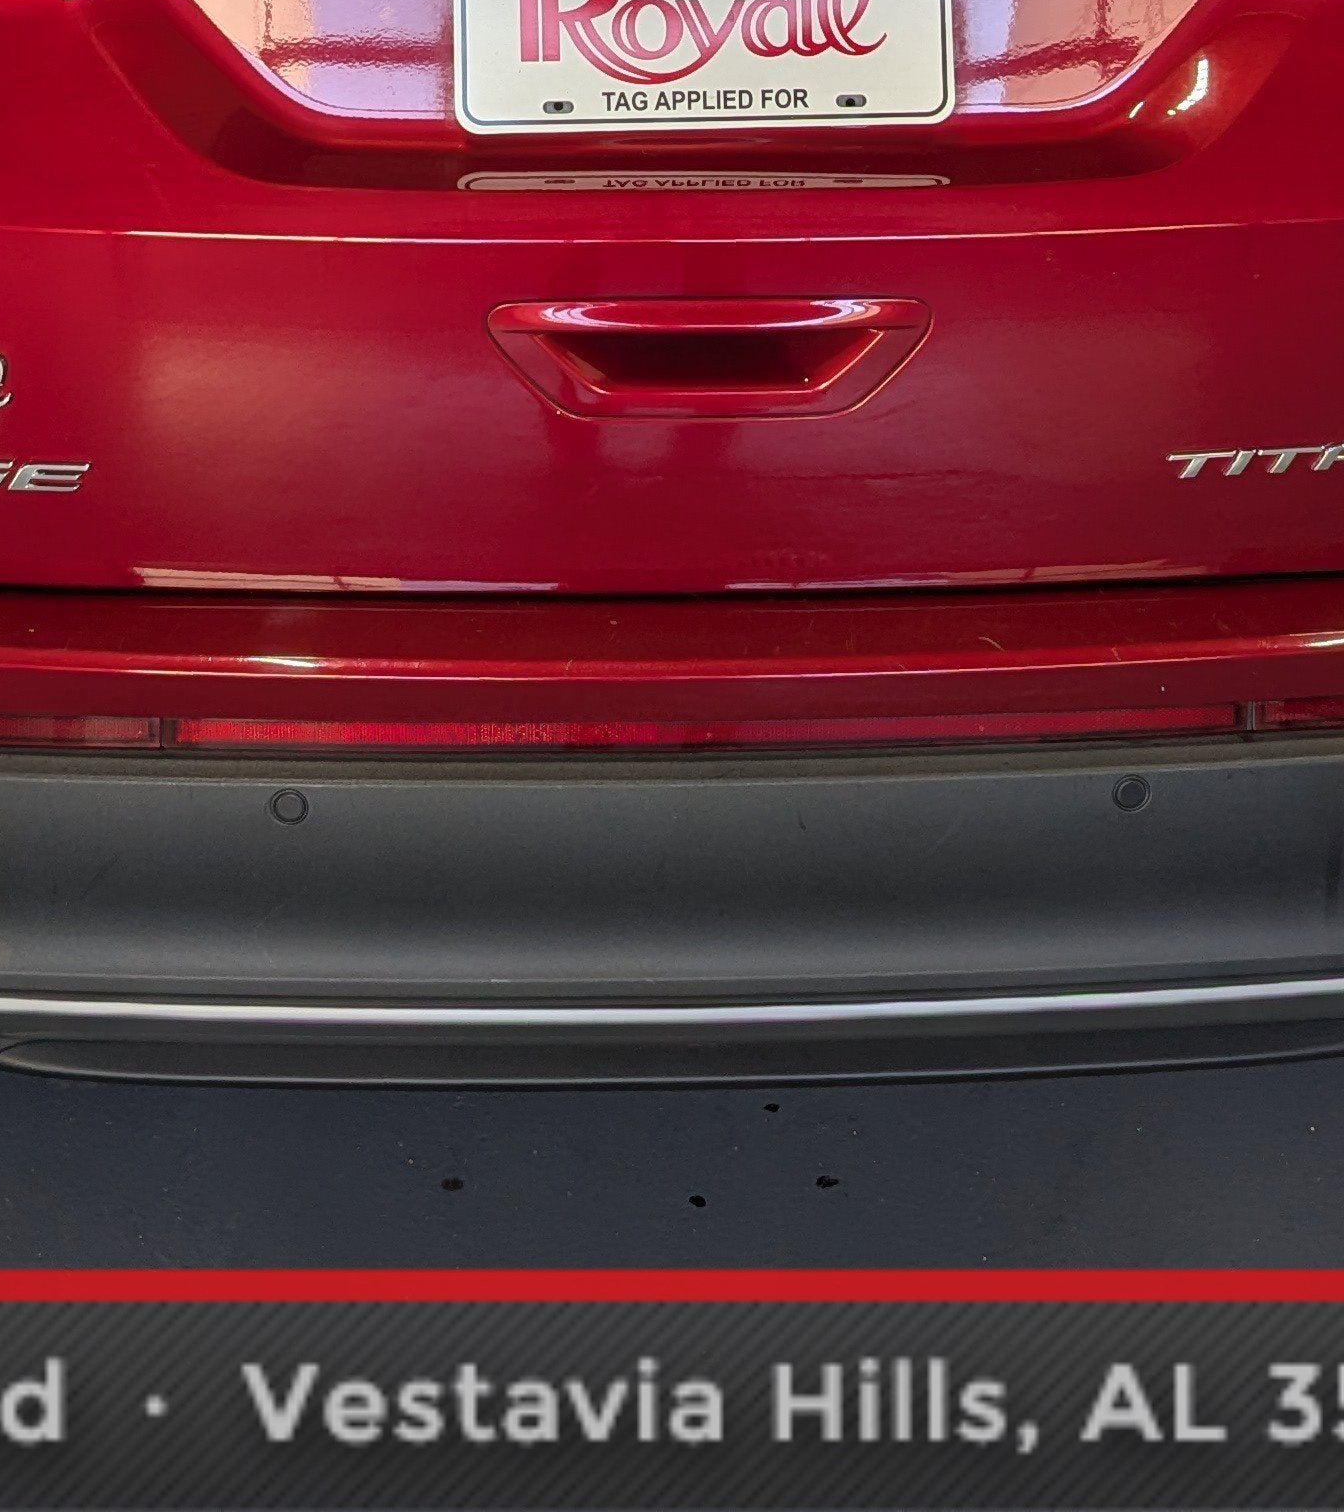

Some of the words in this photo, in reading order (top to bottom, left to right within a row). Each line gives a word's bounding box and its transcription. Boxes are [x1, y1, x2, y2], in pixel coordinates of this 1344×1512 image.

[601, 91, 649, 112] TAG
[654, 90, 754, 111] APPLIED
[760, 88, 809, 109] FOR
